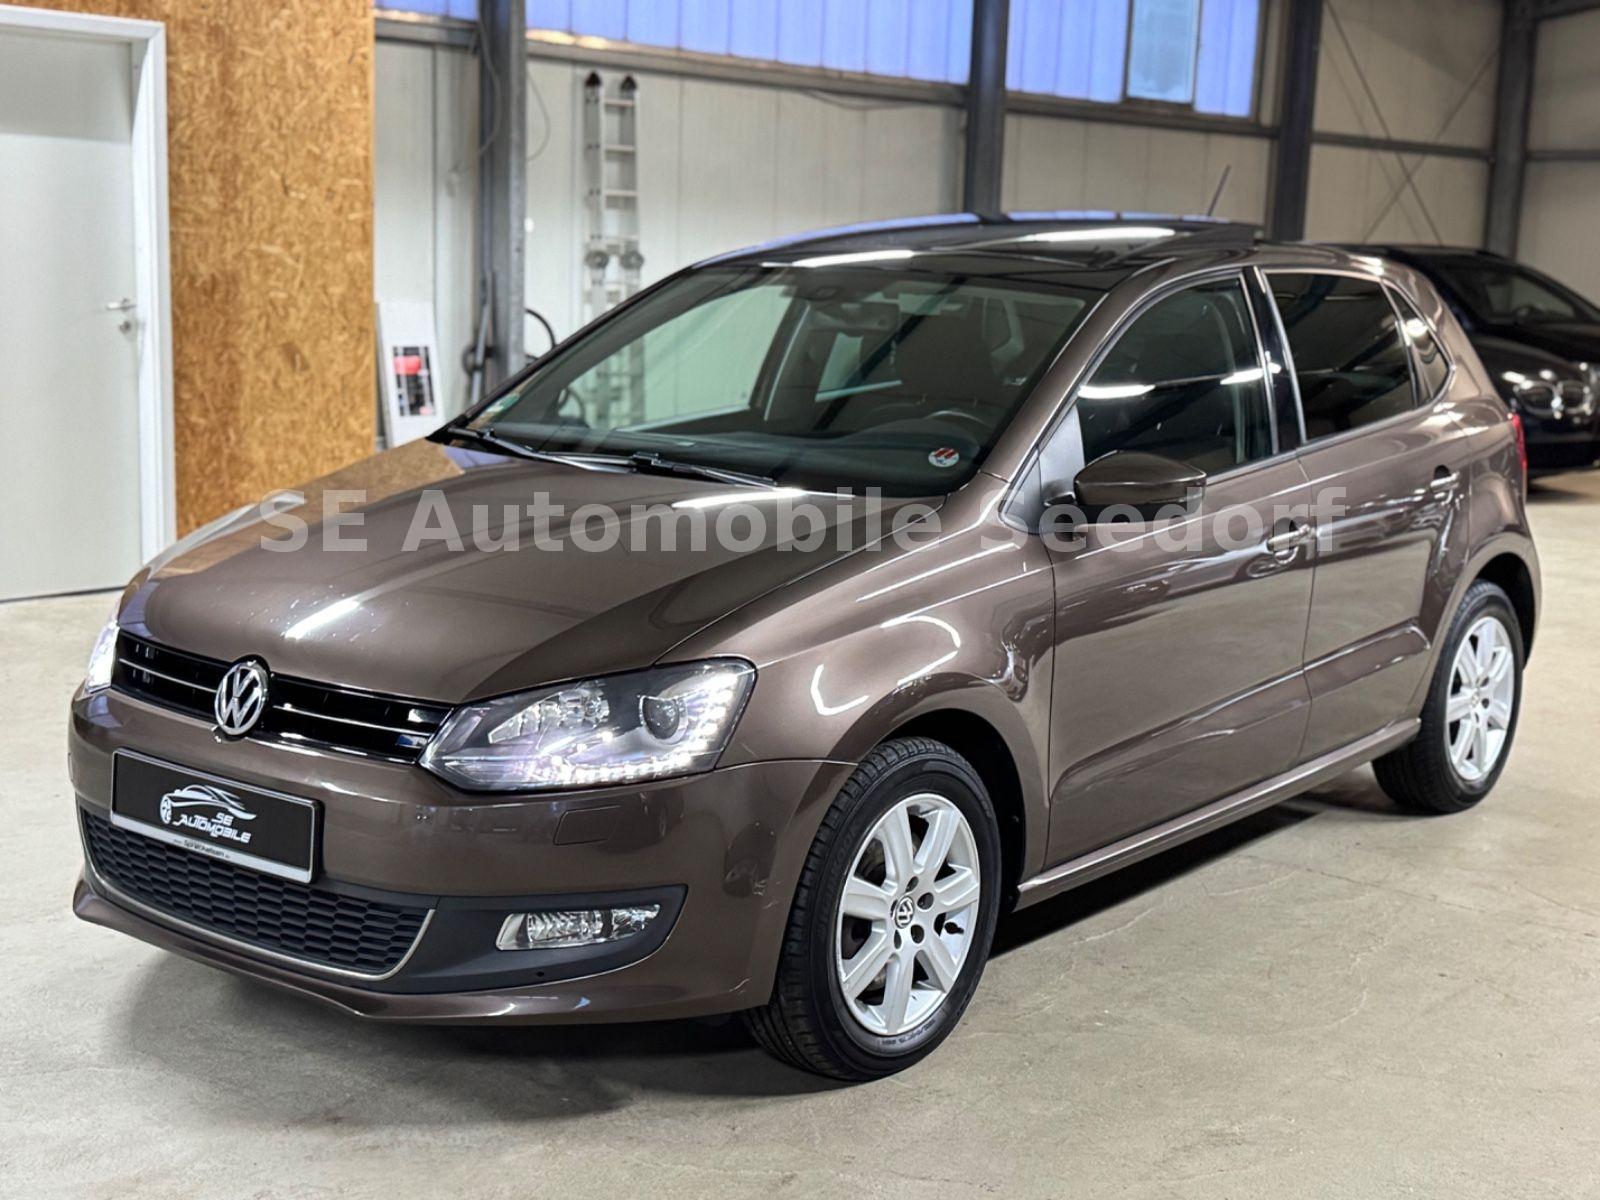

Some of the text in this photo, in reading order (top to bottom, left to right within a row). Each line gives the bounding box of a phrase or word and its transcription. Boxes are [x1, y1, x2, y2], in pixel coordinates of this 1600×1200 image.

[214, 661, 268, 737] VW
[172, 814, 252, 844] AUTOMOBILE
[211, 812, 234, 826] SE
